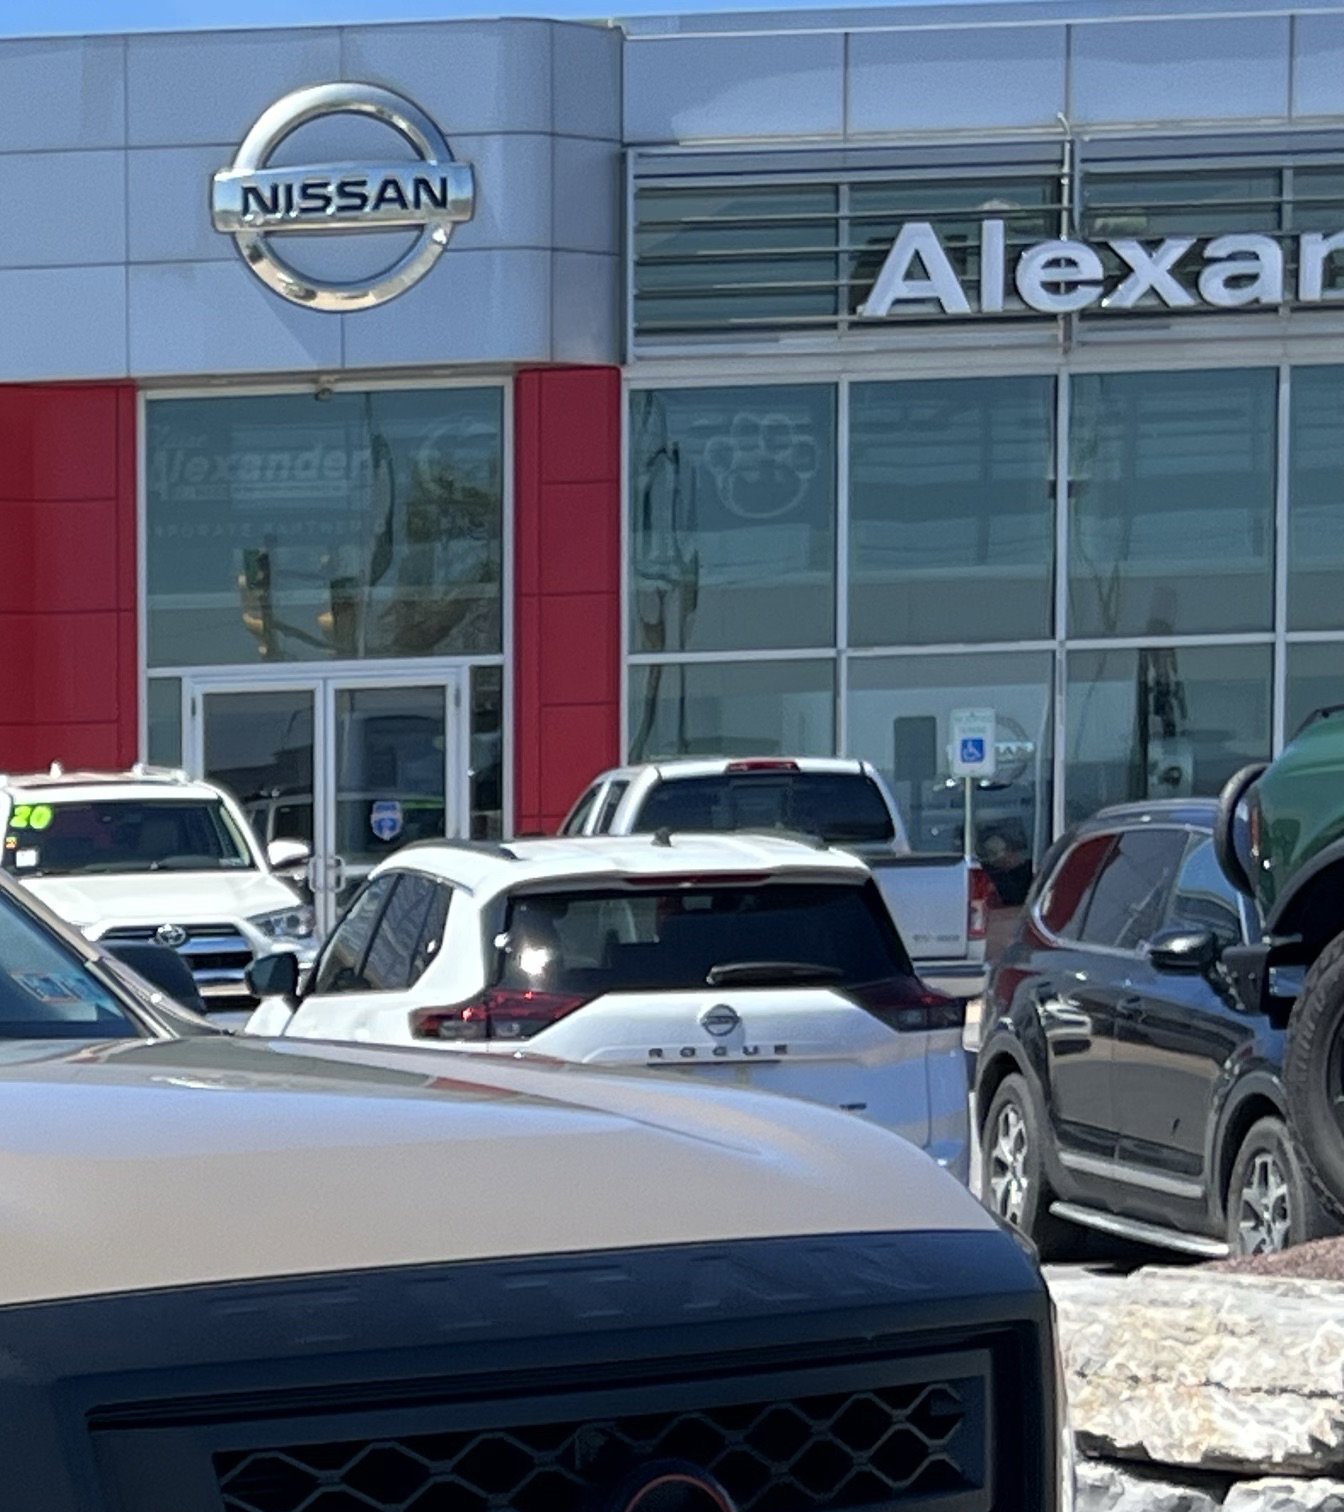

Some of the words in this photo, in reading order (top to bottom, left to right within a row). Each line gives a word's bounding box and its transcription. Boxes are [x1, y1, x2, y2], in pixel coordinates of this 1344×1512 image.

[241, 177, 448, 217] NISSAN
[9, 804, 53, 830] 20
[647, 1043, 789, 1058] ROGUE
